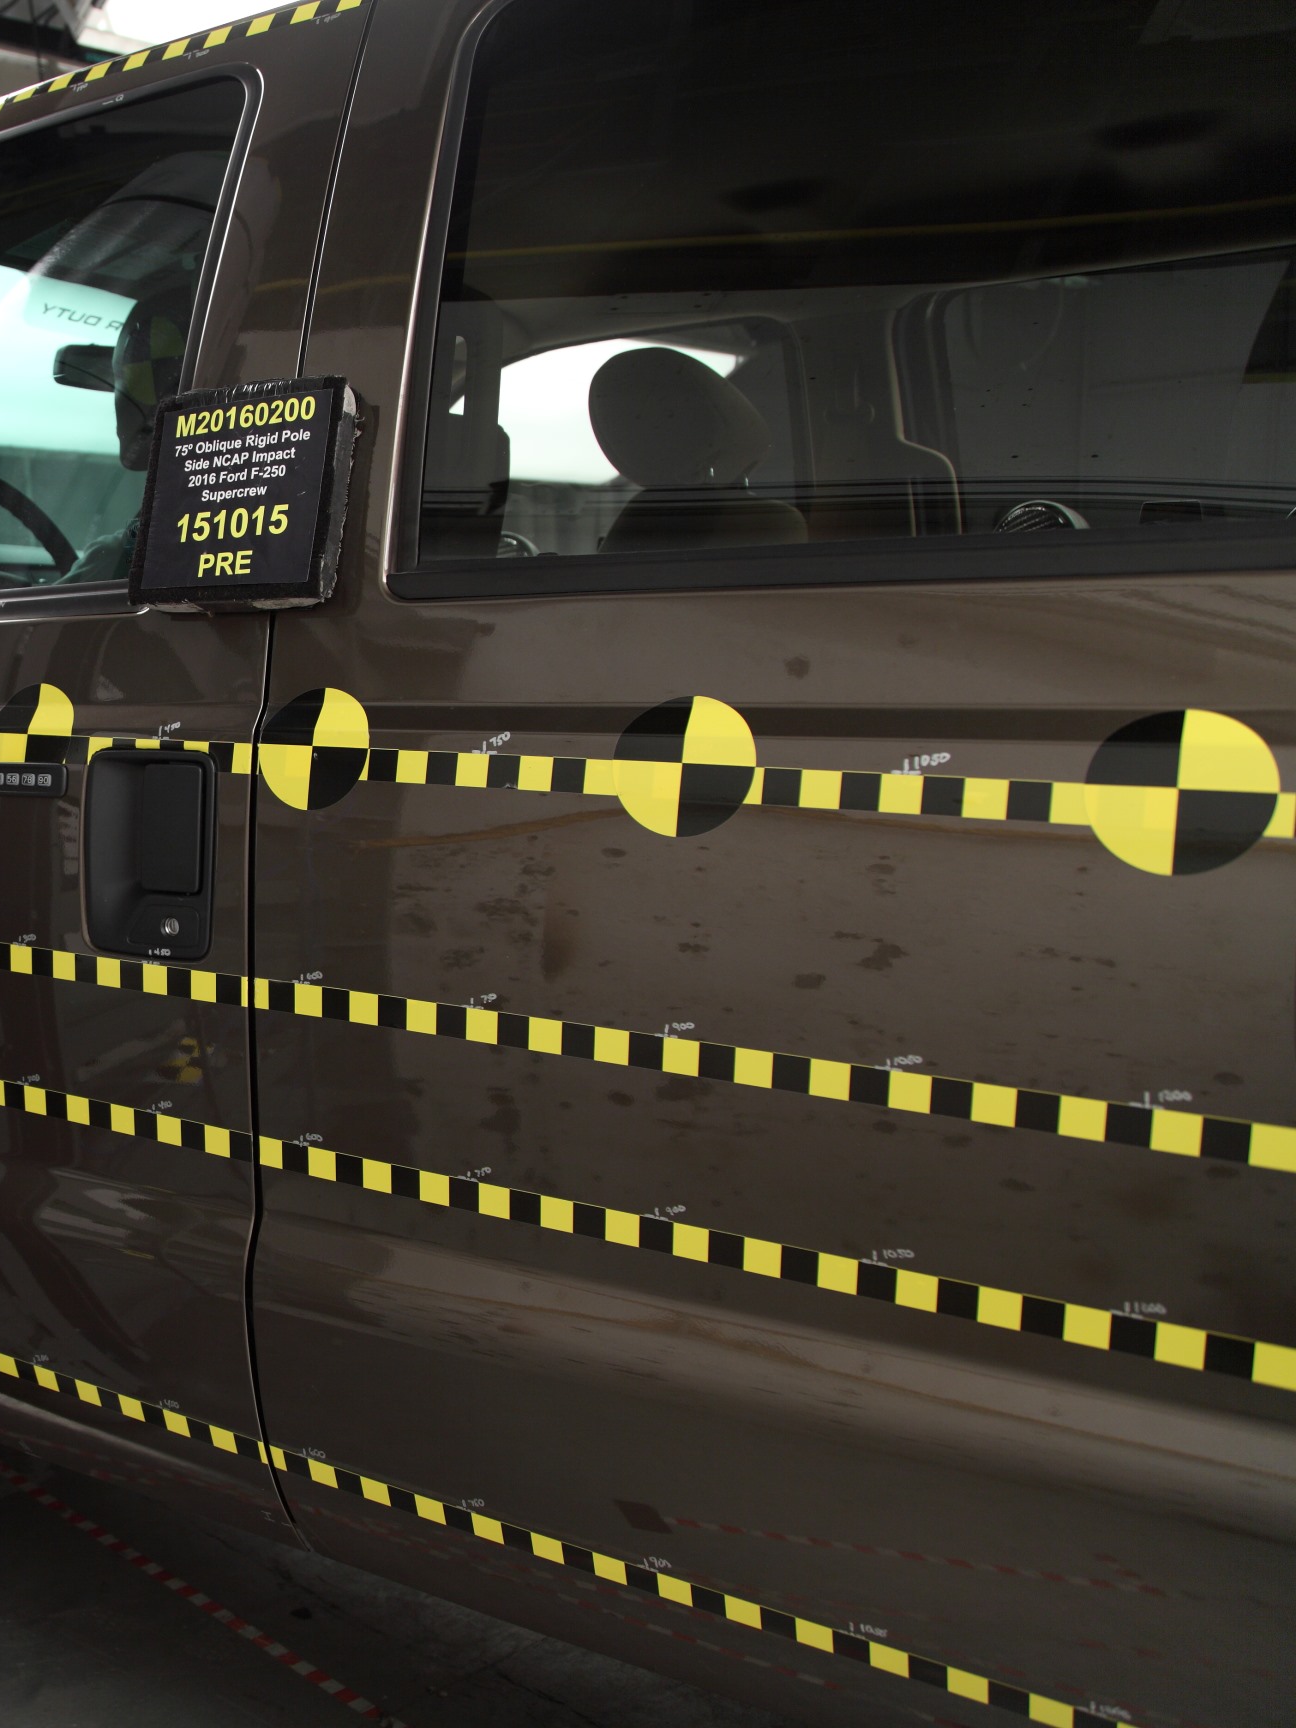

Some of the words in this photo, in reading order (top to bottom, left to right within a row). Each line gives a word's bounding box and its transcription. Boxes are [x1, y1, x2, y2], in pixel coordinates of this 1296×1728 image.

[175, 396, 316, 438] M20160200
[195, 439, 242, 454] Oblique
[245, 431, 279, 448] Rigid
[281, 428, 311, 443] Pole
[184, 458, 210, 472] Side
[212, 451, 250, 468] NCAP
[252, 447, 296, 464] Impact
[187, 472, 217, 488] 2016
[219, 468, 248, 484] Ford
[250, 464, 286, 480] F-250
[201, 485, 268, 502] Supercrew
[177, 503, 290, 543] 151015
[197, 550, 253, 578] PRE
[489, 731, 511, 747] 750
